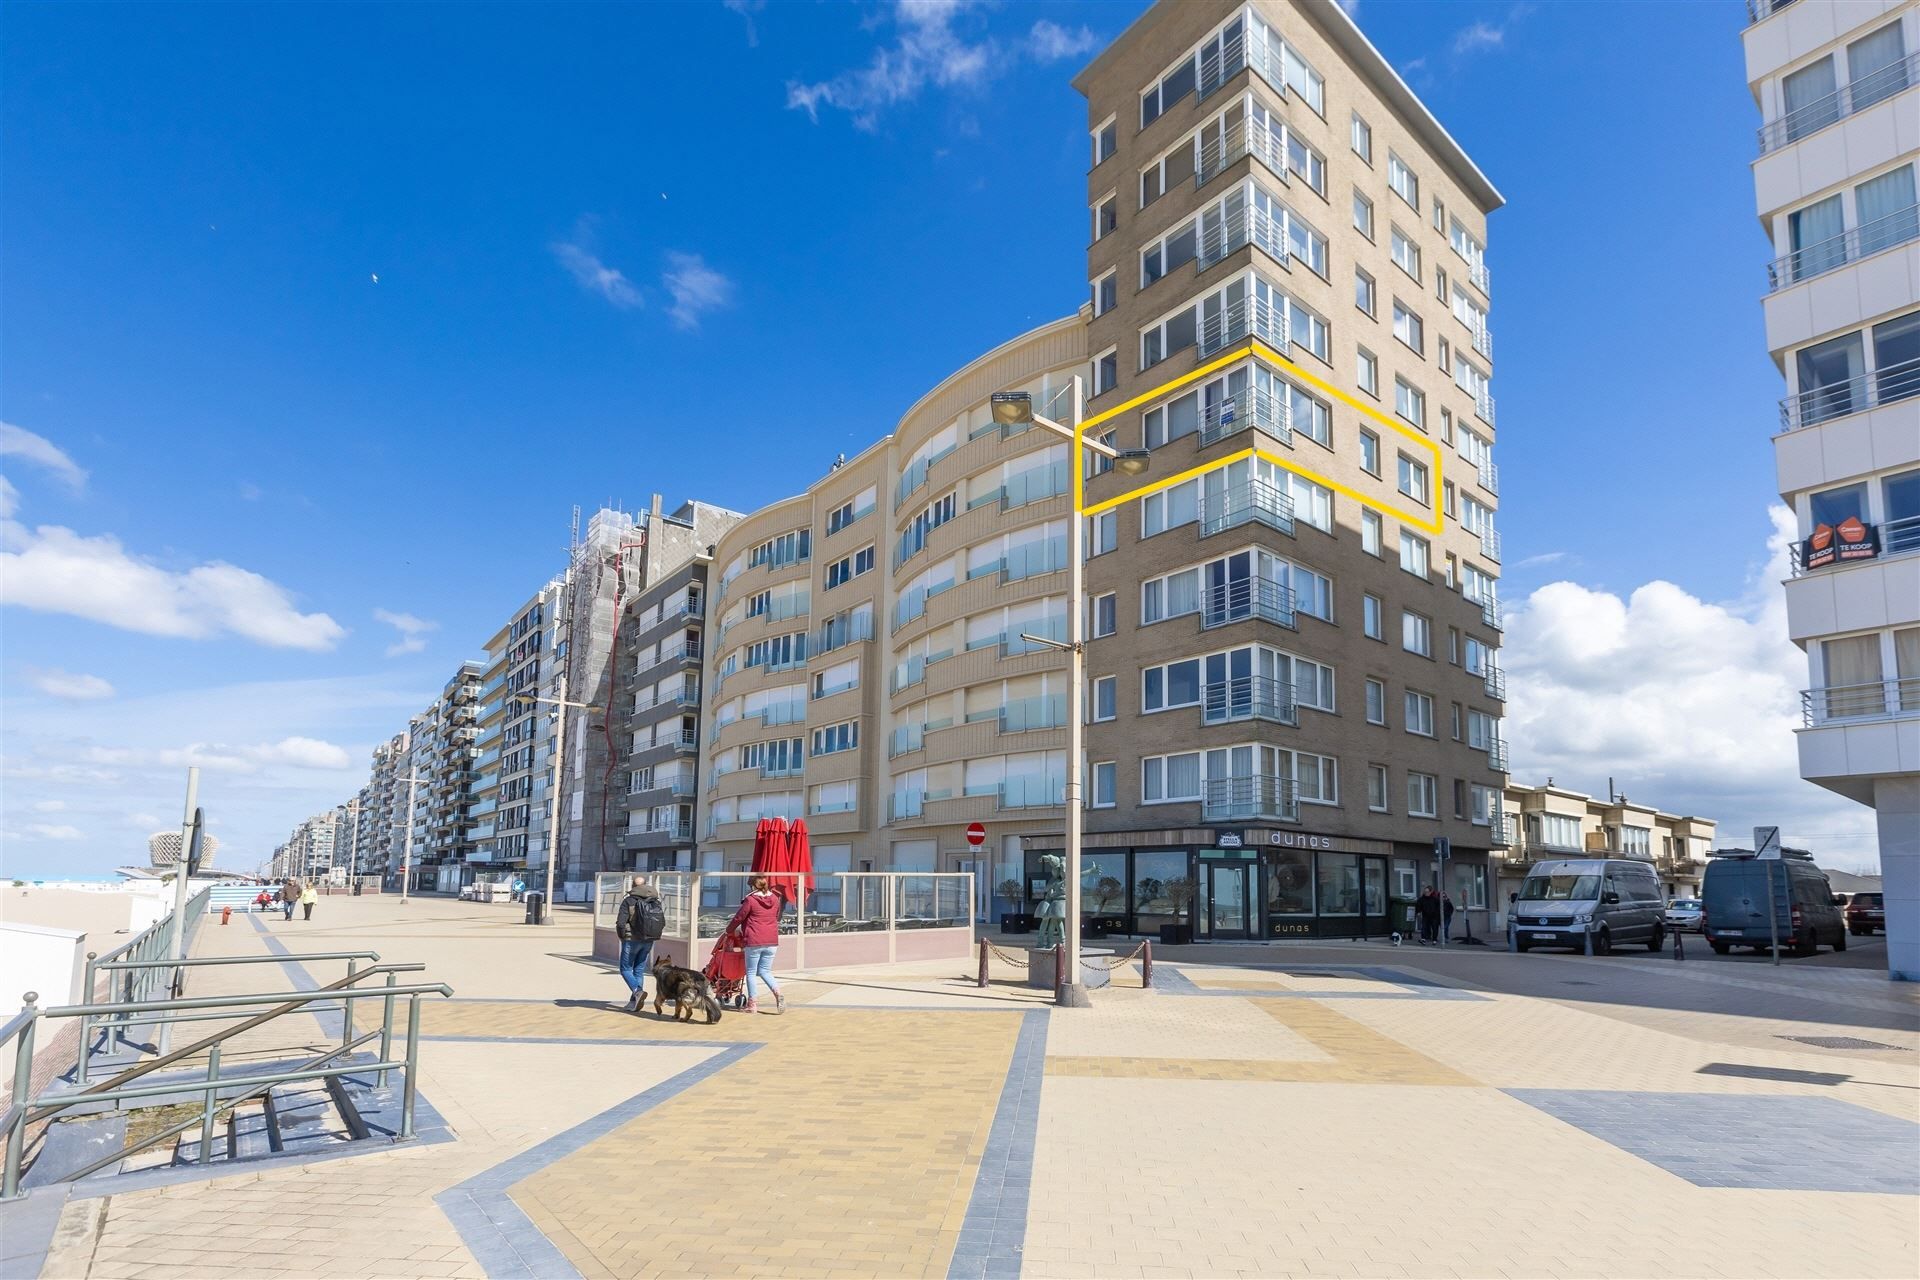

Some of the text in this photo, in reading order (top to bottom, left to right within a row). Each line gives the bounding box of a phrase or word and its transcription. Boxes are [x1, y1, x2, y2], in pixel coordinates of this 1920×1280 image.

[1817, 547, 1834, 556] KOOP
[1271, 831, 1330, 848] dunas
[1274, 923, 1310, 932] dunas
